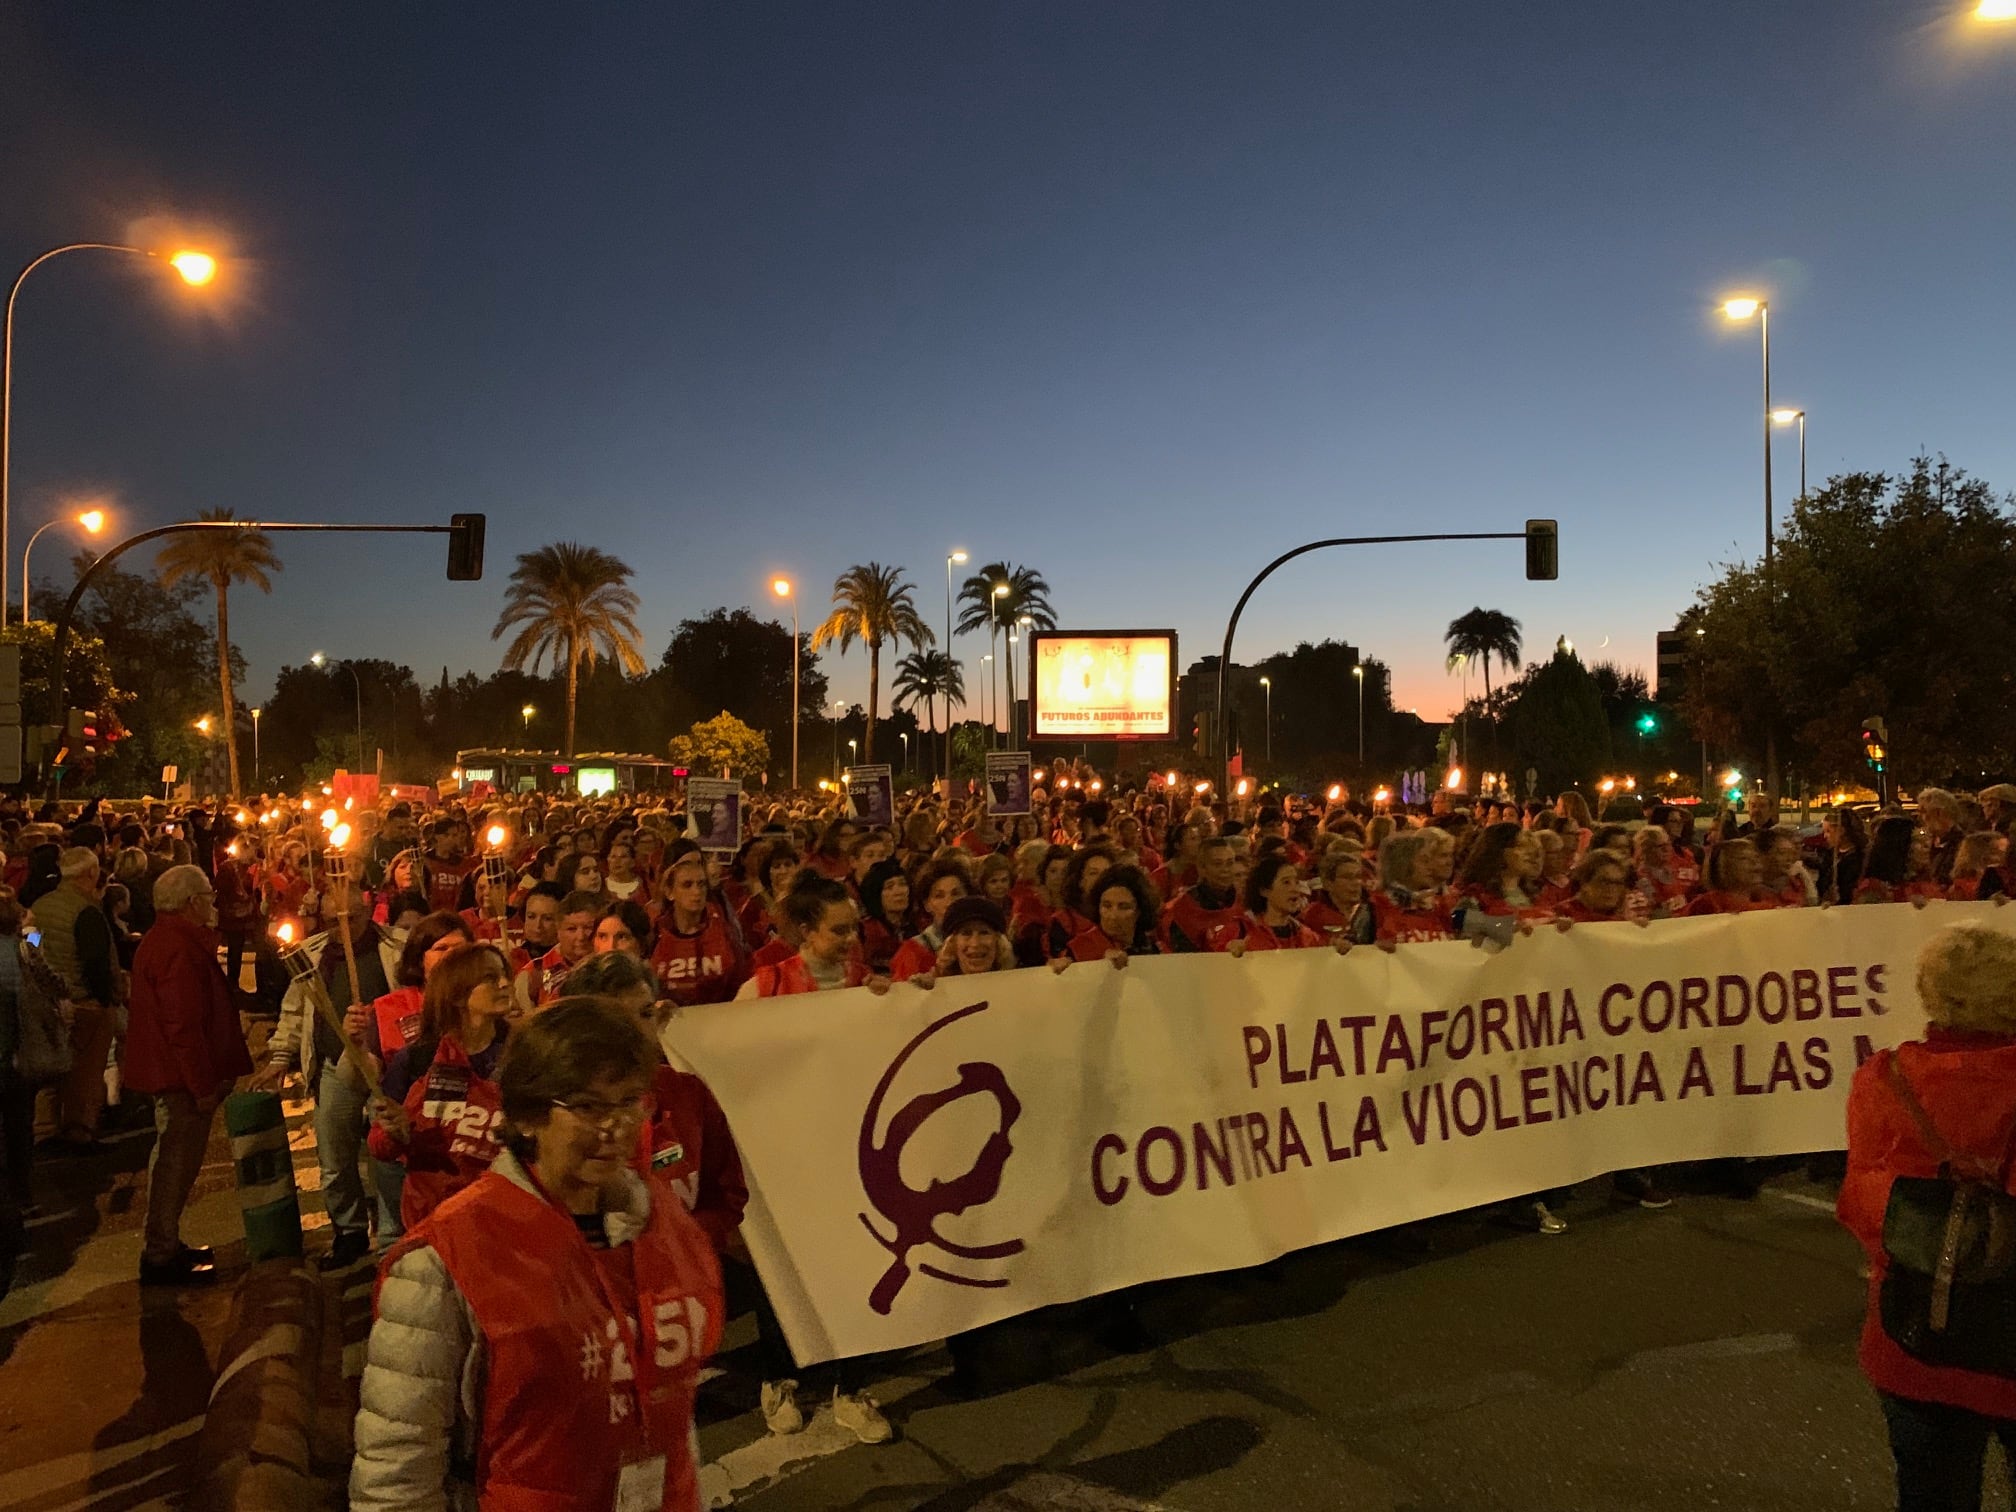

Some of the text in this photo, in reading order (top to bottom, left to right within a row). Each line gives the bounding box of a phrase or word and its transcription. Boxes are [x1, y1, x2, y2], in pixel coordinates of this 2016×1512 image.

[1041, 711, 1164, 721] FUTUROS ABUNDANTES
[1242, 988, 1584, 1089] PLATAFORMA
[1091, 1107, 1312, 1206] CONTRA
[1318, 1096, 1388, 1163] LA
[1402, 1051, 1665, 1145] VIOLENCIA
[1677, 1047, 1715, 1100] A
[1733, 1037, 1833, 1096] LAS
